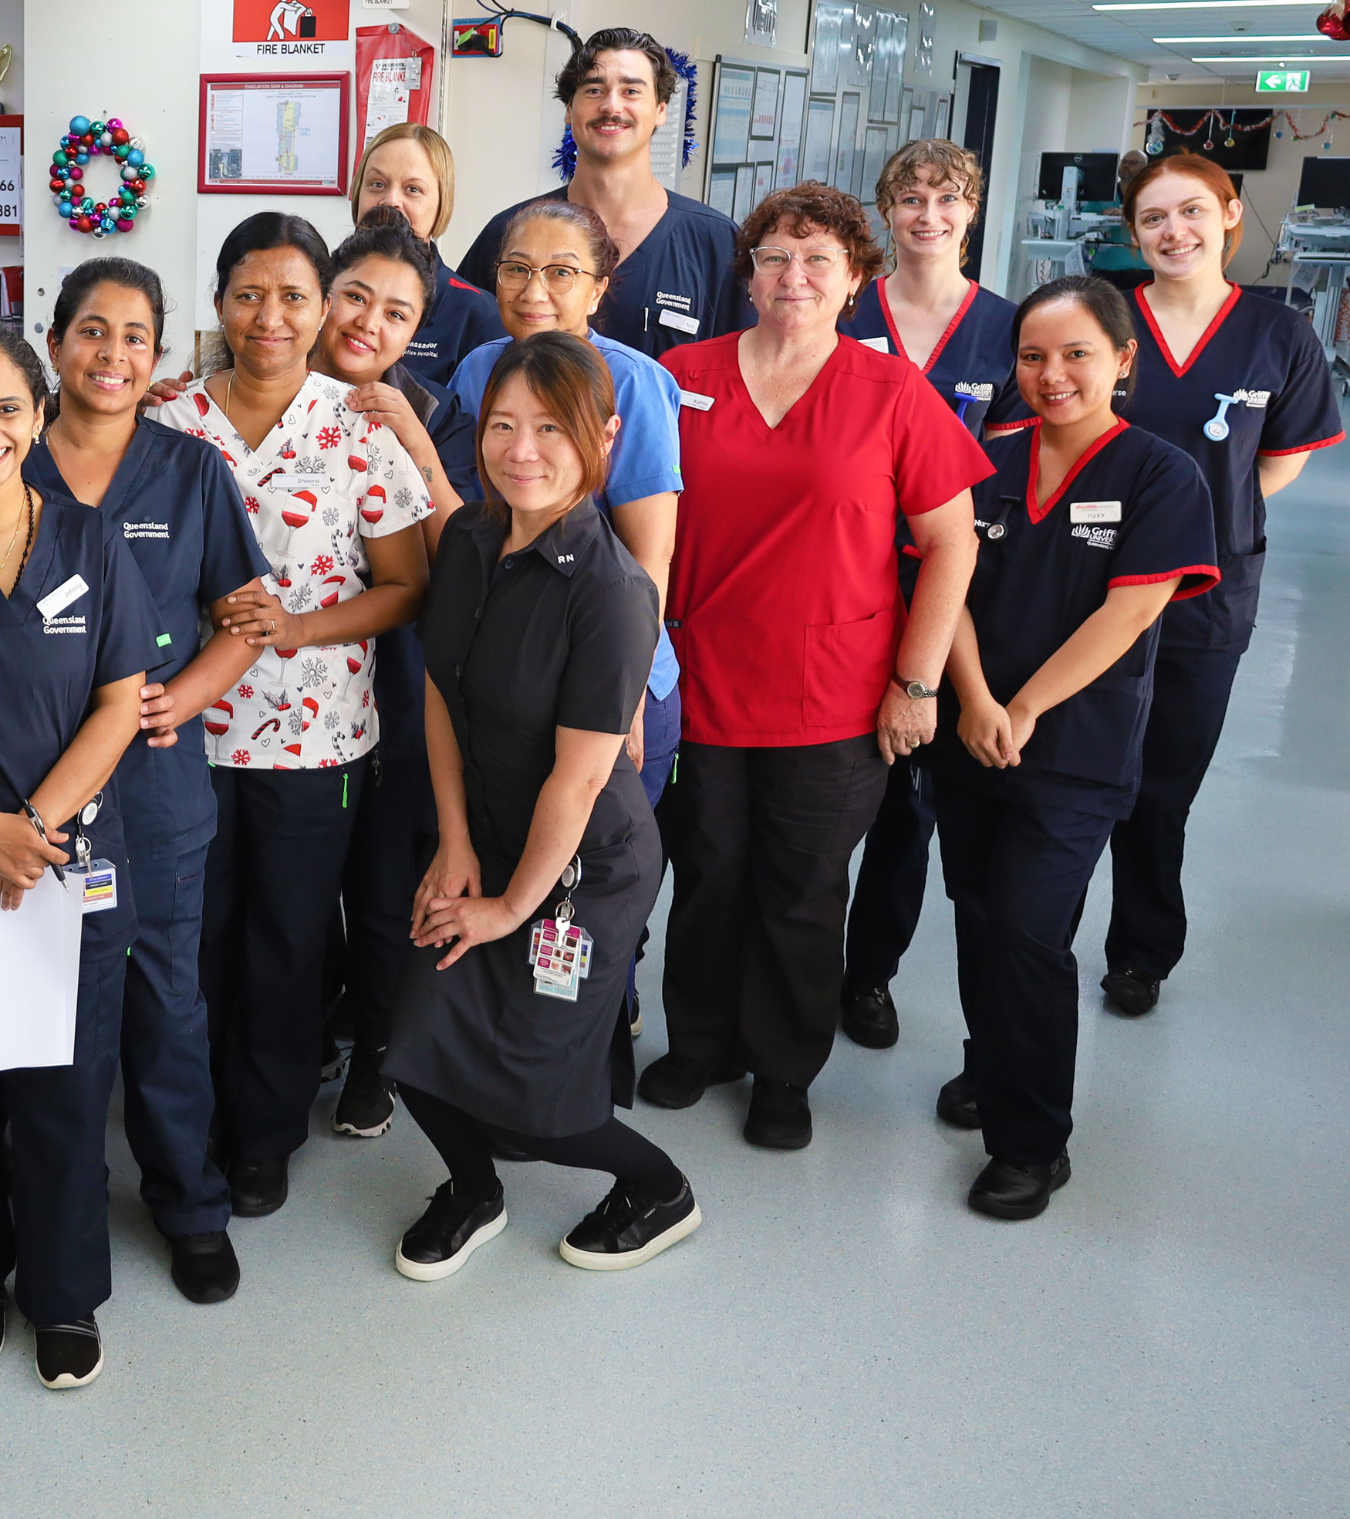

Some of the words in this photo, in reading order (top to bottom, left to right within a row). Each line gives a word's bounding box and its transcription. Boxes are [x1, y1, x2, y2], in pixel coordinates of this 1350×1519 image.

[256, 44, 278, 55] FIRE
[281, 43, 326, 55] BLANKET
[656, 291, 691, 305] Queensland
[655, 298, 690, 311] Government
[123, 521, 169, 532] Queensland
[123, 530, 170, 539] Government
[557, 553, 575, 564] RN
[42, 615, 86, 626] Queensland
[43, 625, 87, 634] Government
